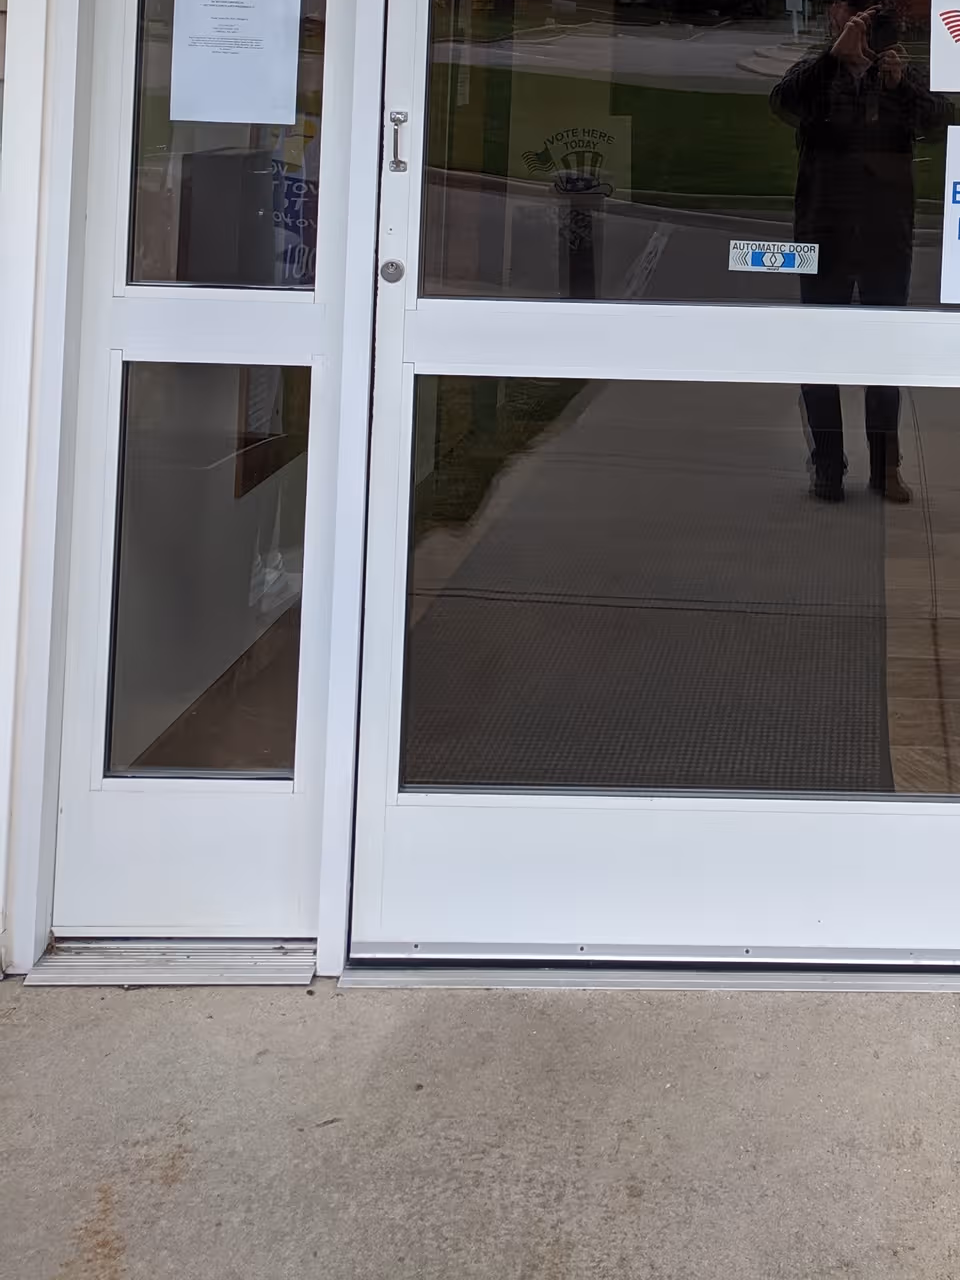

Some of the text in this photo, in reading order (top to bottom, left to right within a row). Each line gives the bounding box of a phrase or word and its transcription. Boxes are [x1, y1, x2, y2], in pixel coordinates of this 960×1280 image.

[546, 128, 616, 145] VOTE HERE
[563, 139, 599, 151] TODAY
[732, 242, 816, 254] AUTOMATIC DOOR
